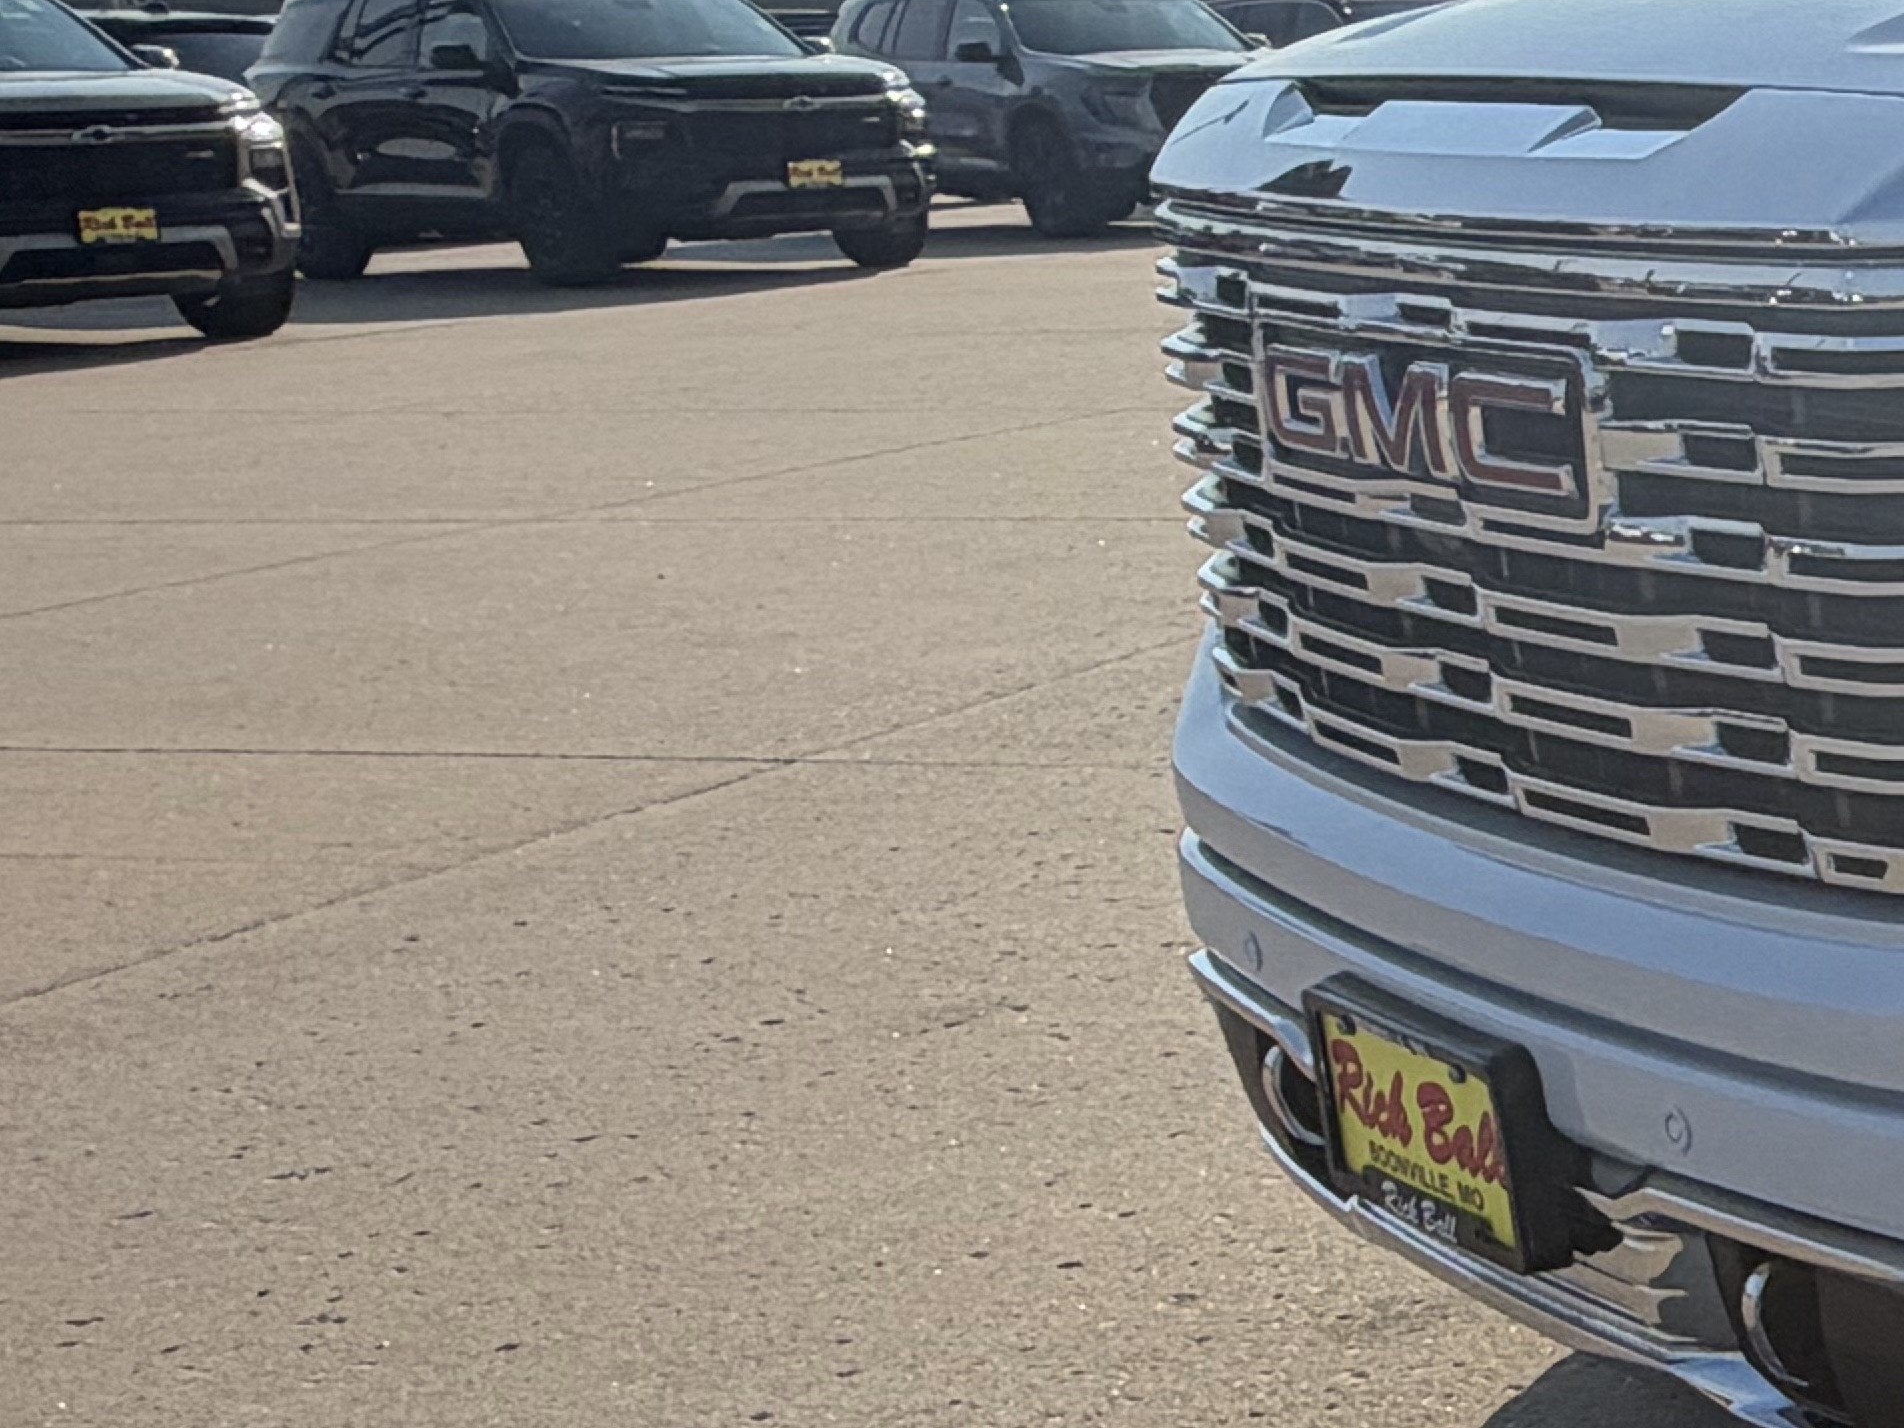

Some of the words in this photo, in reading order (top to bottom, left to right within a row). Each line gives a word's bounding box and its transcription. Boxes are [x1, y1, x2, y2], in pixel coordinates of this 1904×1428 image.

[1265, 343, 1577, 499] GMC
[1331, 1039, 1412, 1148] Rick
[1417, 1081, 1505, 1183] Ball
